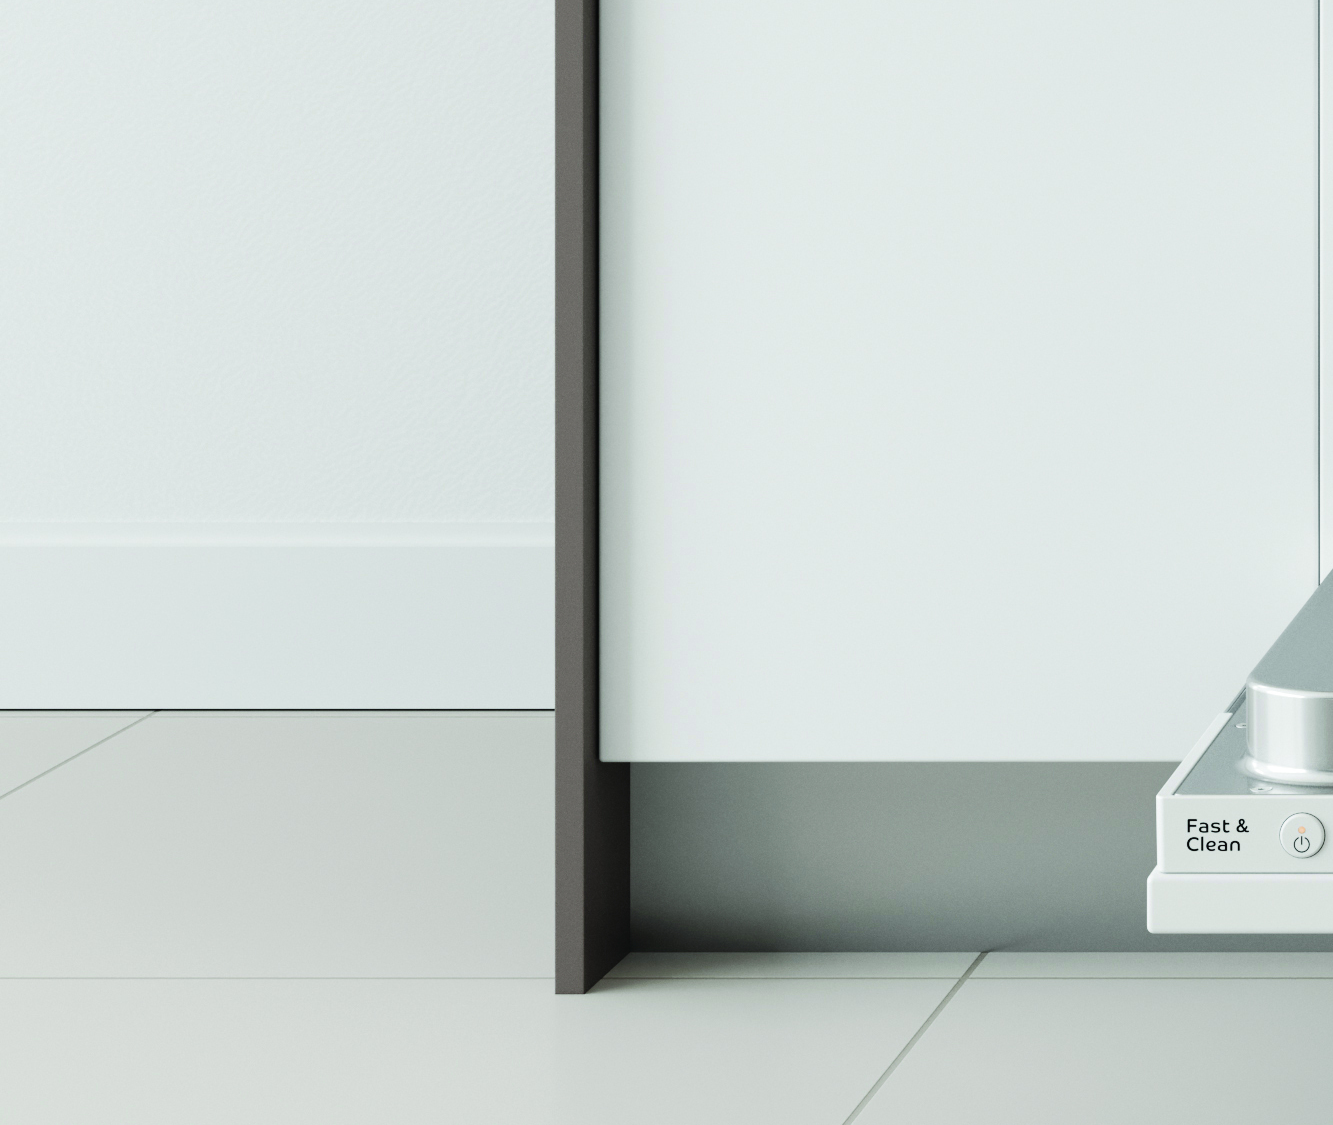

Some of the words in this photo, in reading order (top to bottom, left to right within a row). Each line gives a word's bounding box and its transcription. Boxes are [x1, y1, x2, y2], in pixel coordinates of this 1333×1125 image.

[1187, 818, 1230, 833] Fast
[1236, 818, 1250, 833] &
[1186, 836, 1241, 852] Clean
